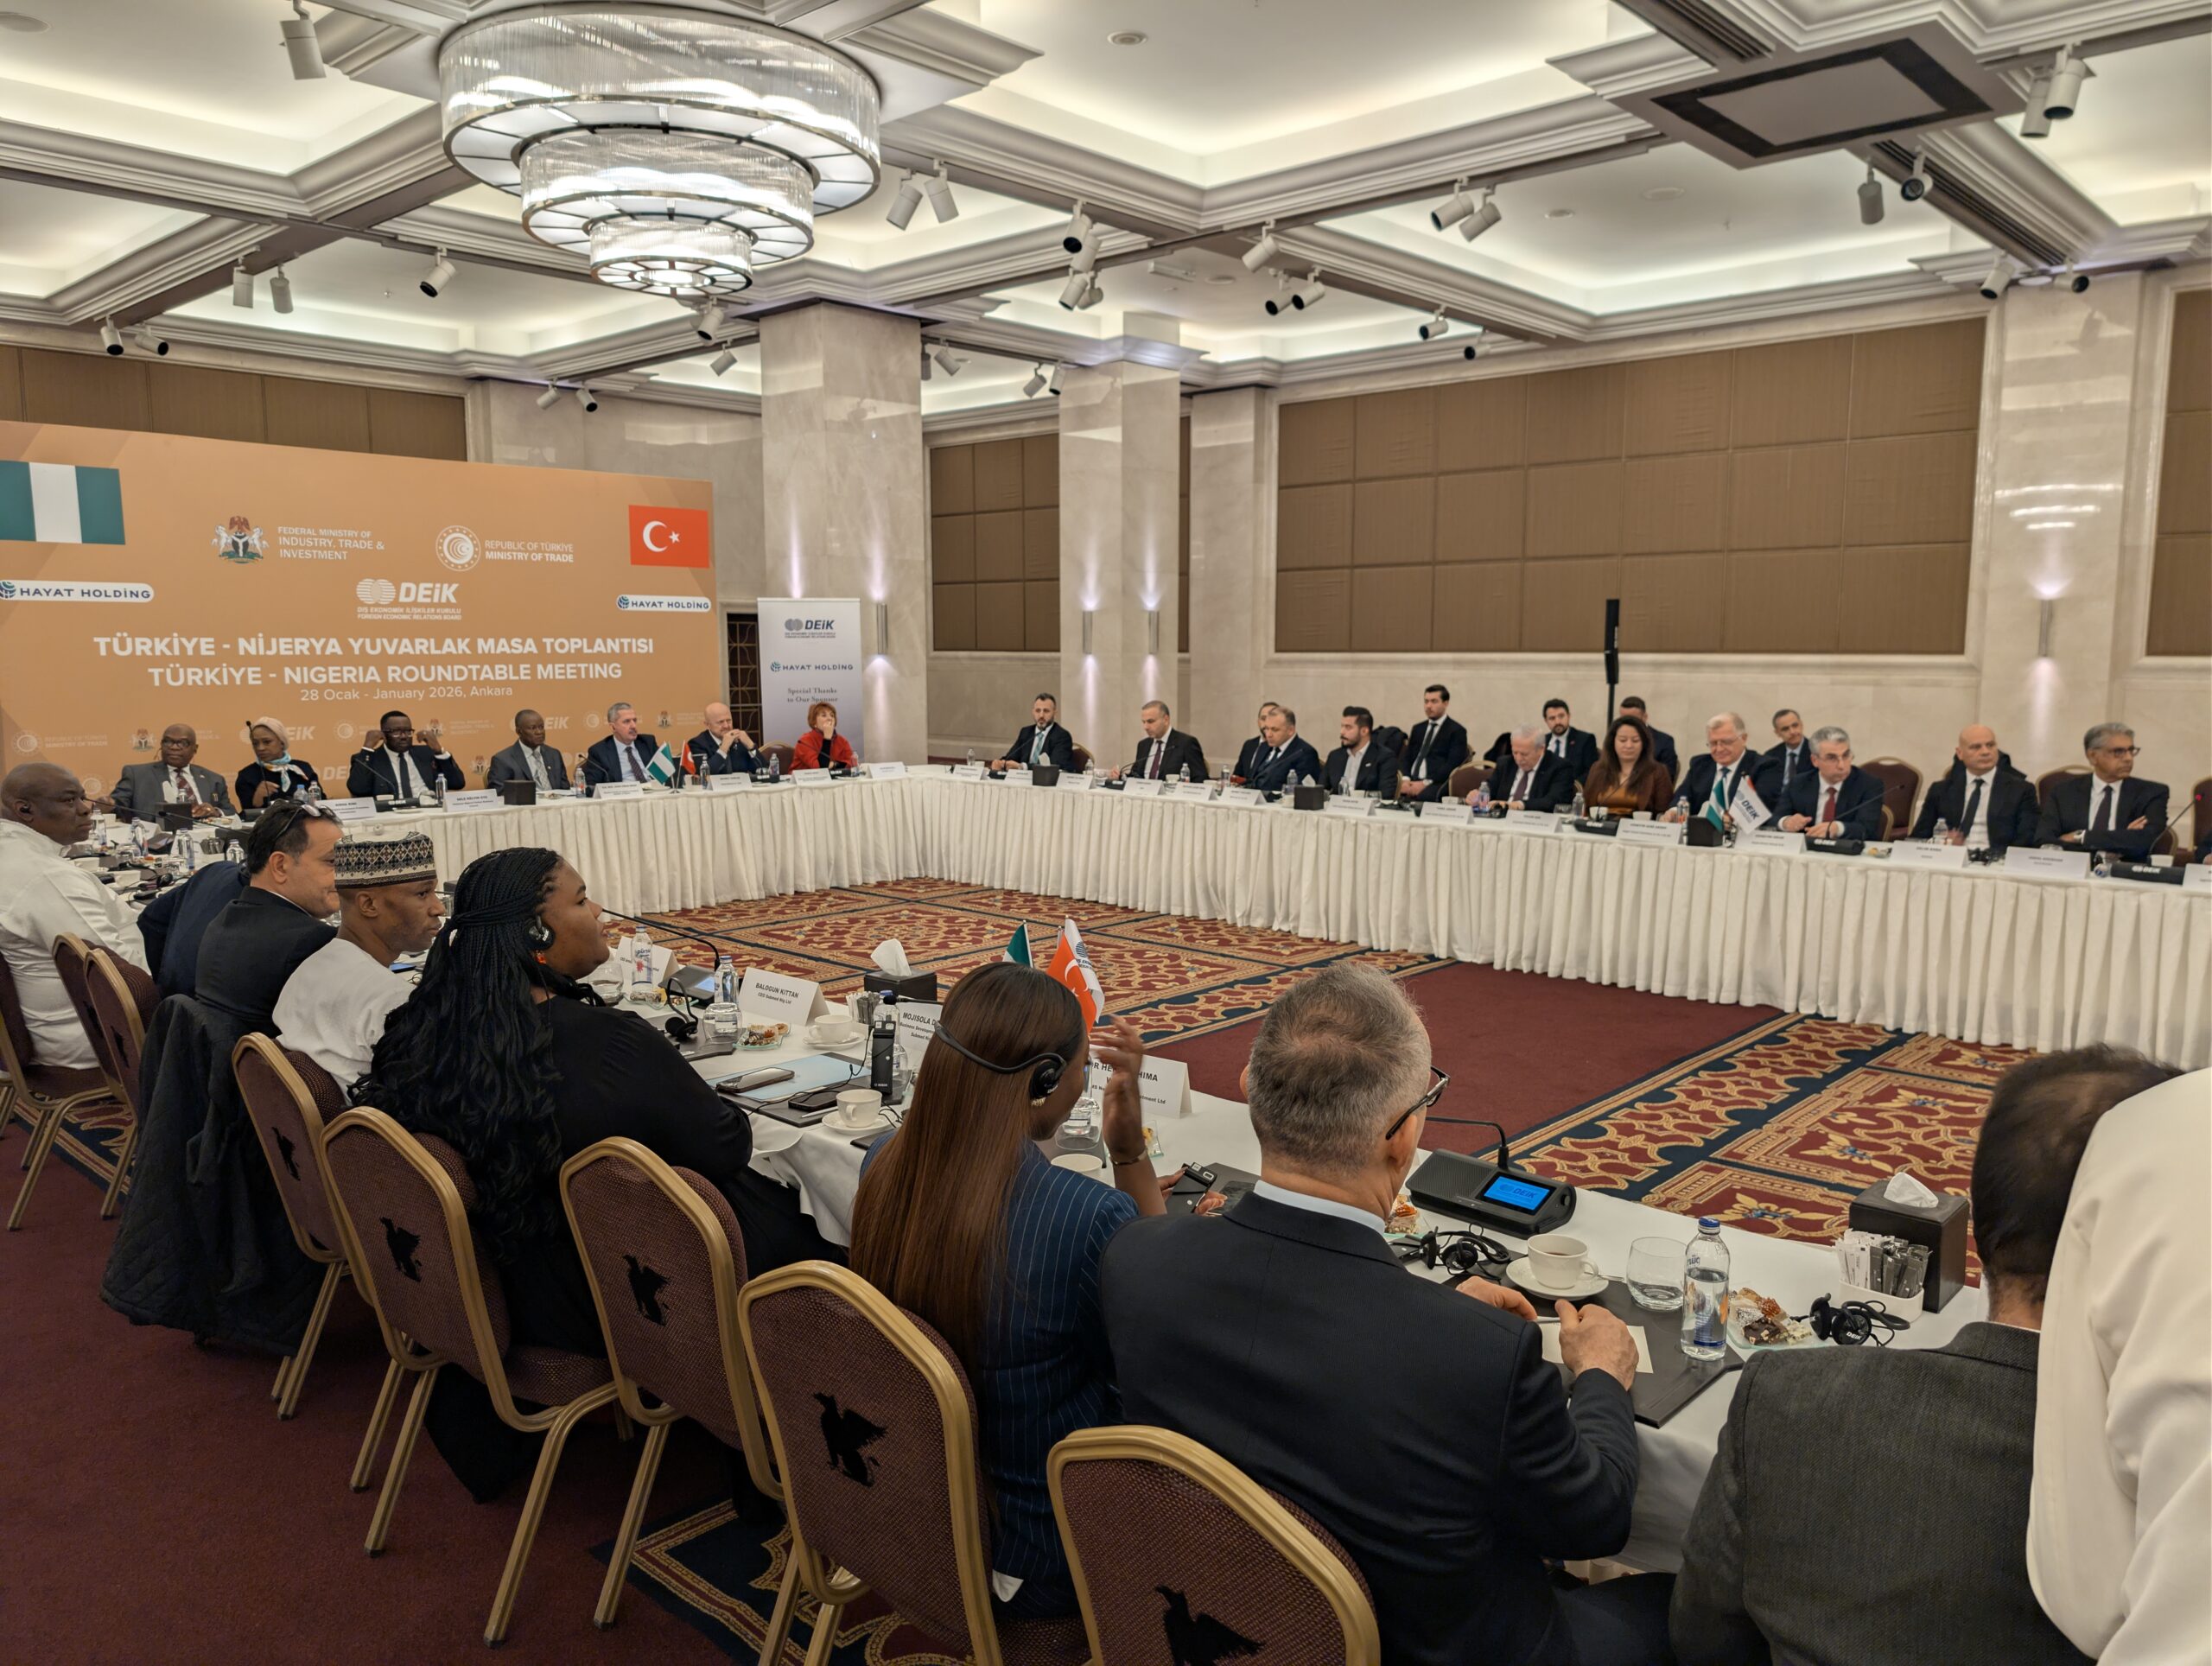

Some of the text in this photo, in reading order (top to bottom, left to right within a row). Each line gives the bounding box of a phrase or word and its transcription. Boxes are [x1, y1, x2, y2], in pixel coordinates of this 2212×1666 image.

[278, 526, 317, 536] FEDERAL
[319, 529, 359, 537] MINISTRY
[338, 539, 373, 550] TRADE
[376, 541, 385, 550] &
[485, 540, 525, 550] REPUBLIC
[527, 542, 538, 550] OF
[280, 549, 348, 560] INVESTMENT
[486, 551, 529, 560] MINISTRY
[545, 553, 574, 563] TRADE
[21, 588, 74, 596] HAYAT
[93, 632, 215, 656] TÜRKİYE
[238, 633, 343, 656] NİJERYA
[348, 638, 472, 655] YUVARLAK
[477, 638, 538, 654] MASA
[543, 638, 653, 653] TOPLANTISI
[148, 663, 262, 686] TÜRKİYE
[283, 665, 381, 684] NIGERIA
[388, 664, 531, 683] ROUNDTABLE
[537, 663, 622, 679] MEETING
[301, 690, 319, 701] 28
[324, 688, 359, 700] Ocak
[373, 687, 425, 701] January
[429, 686, 467, 698] 2026,
[470, 686, 512, 697] Ankara
[756, 982, 799, 998] BALOGUN KITTAN
[903, 1012, 931, 1025] MOJISOLA
